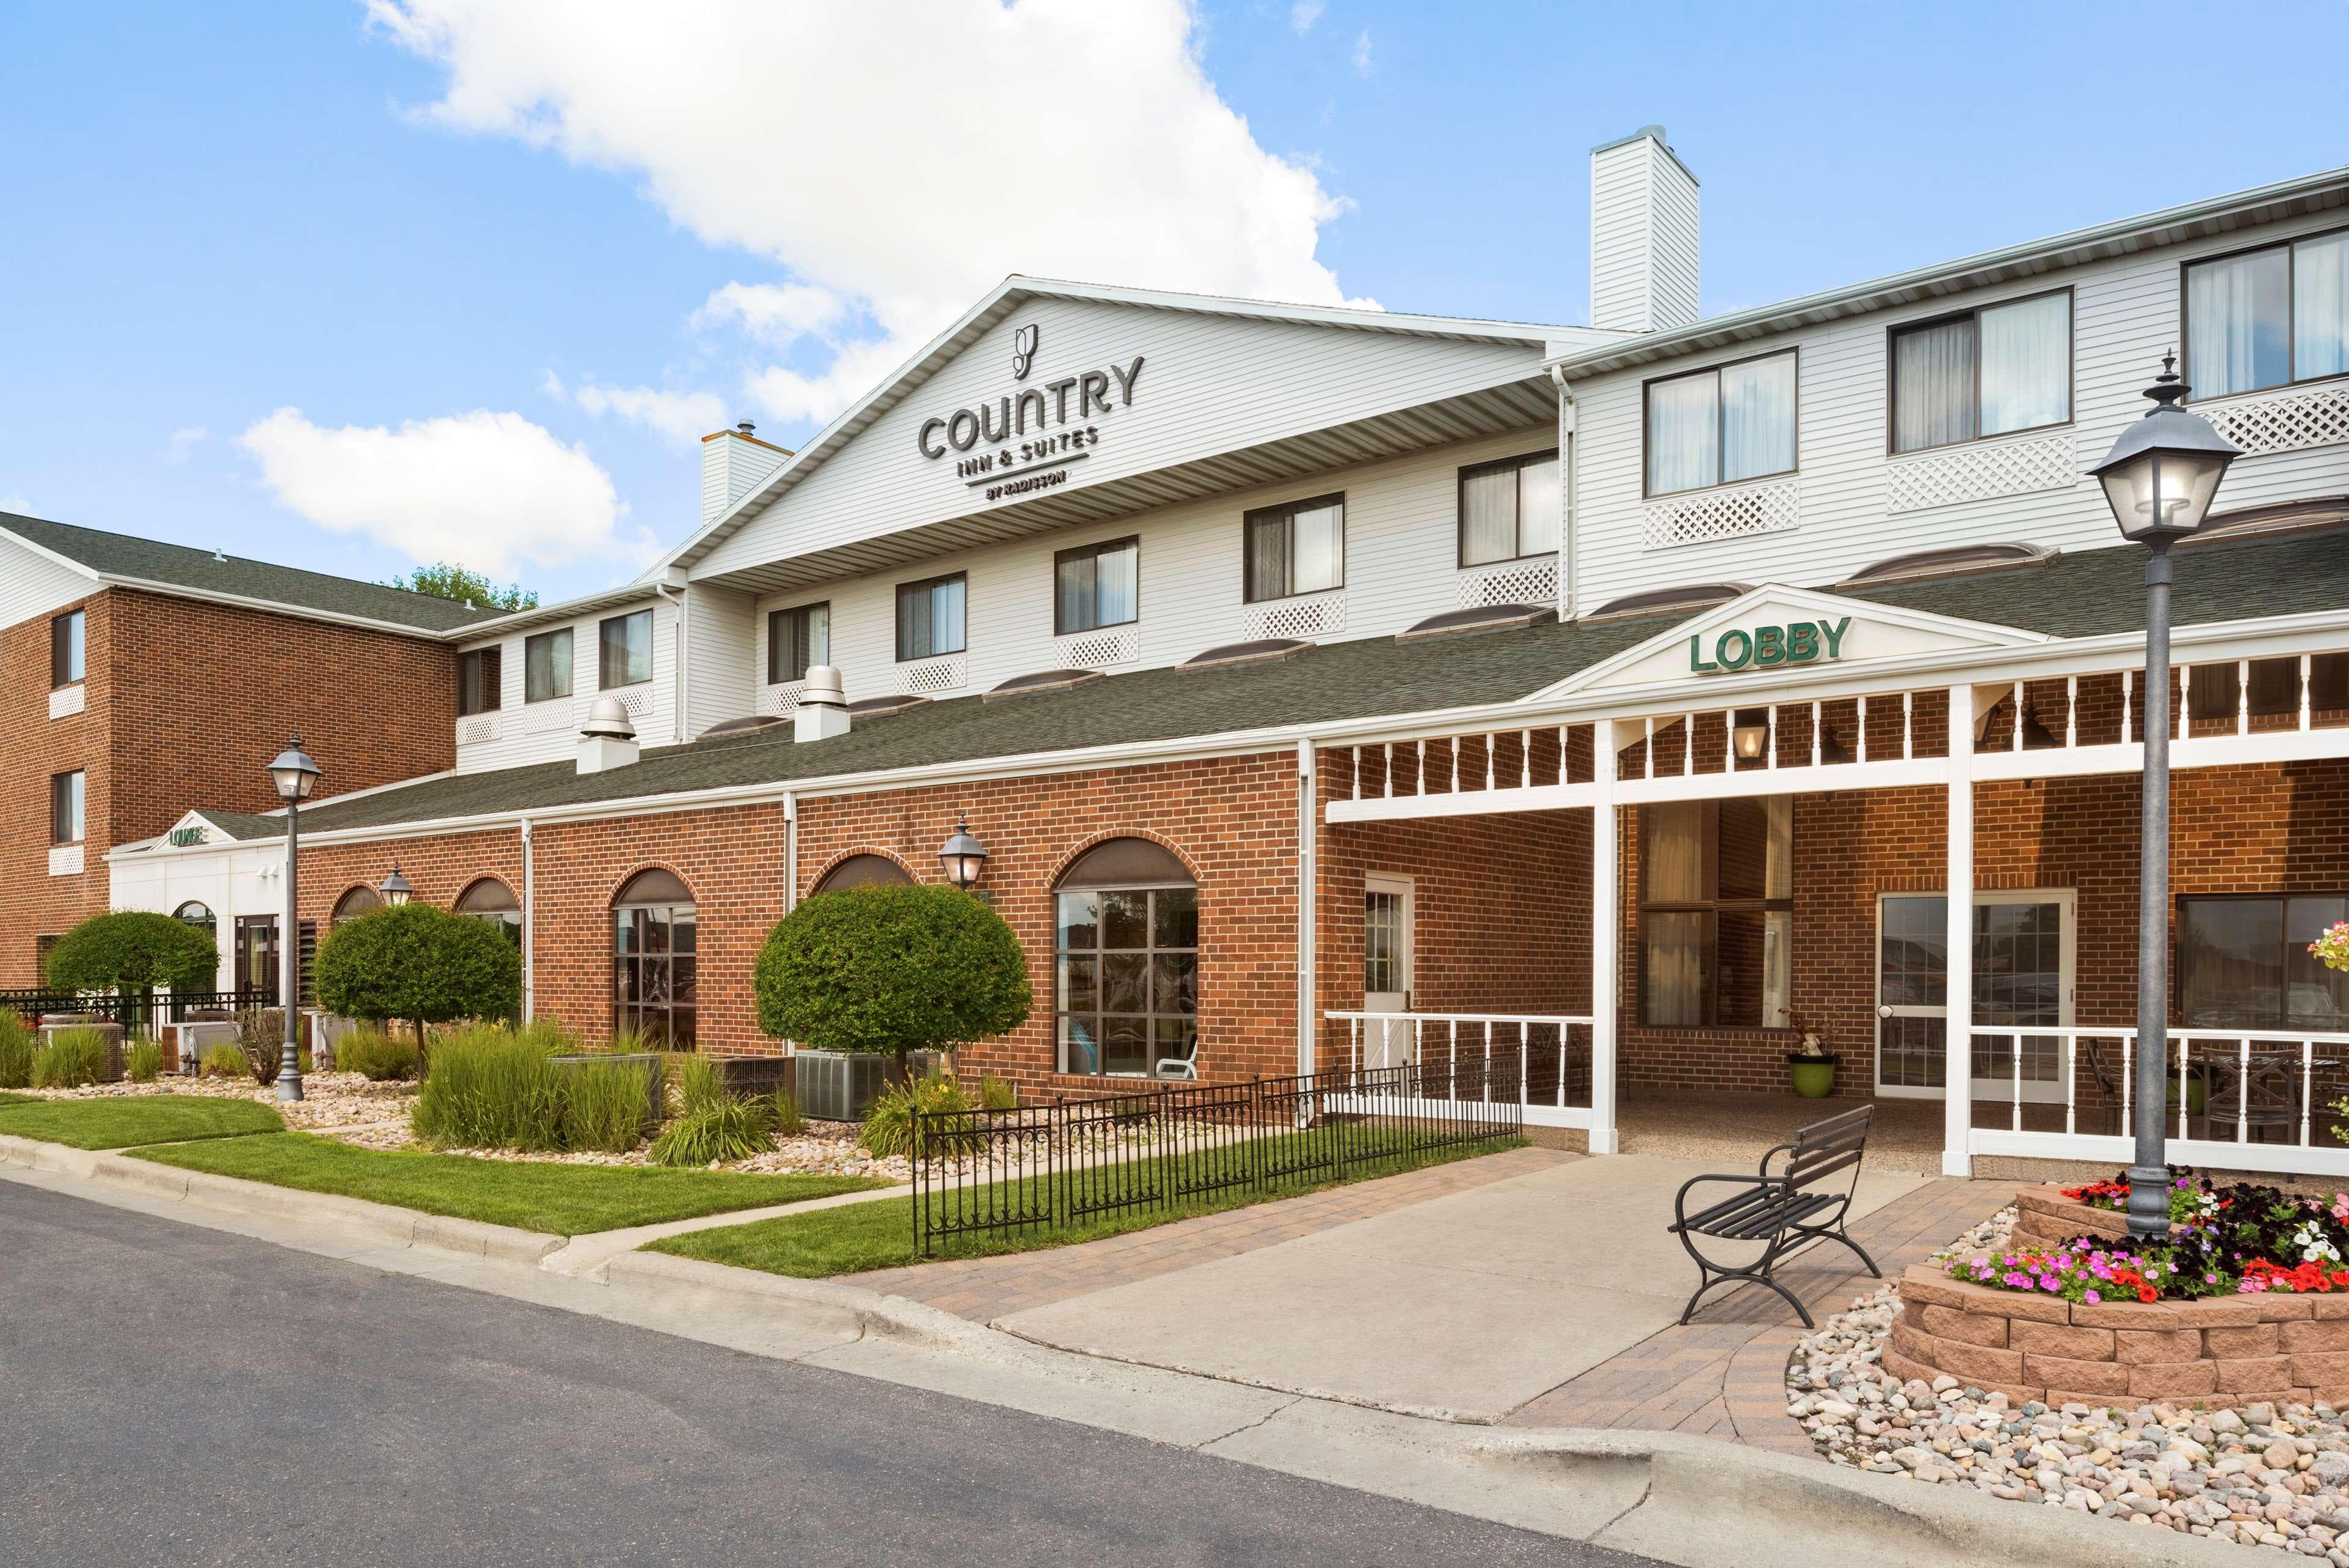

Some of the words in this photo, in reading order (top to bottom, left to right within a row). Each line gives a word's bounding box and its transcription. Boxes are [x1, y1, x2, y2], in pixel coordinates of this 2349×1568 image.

[918, 356, 1145, 459] COUNTRY
[958, 455, 992, 478] INN
[999, 450, 1013, 466] &
[1020, 426, 1098, 461] SUITES
[986, 486, 1003, 500] BY
[1003, 470, 1067, 496] RADISSON
[1691, 617, 1852, 672] LOBBY
[169, 826, 203, 846] LOUNGE
